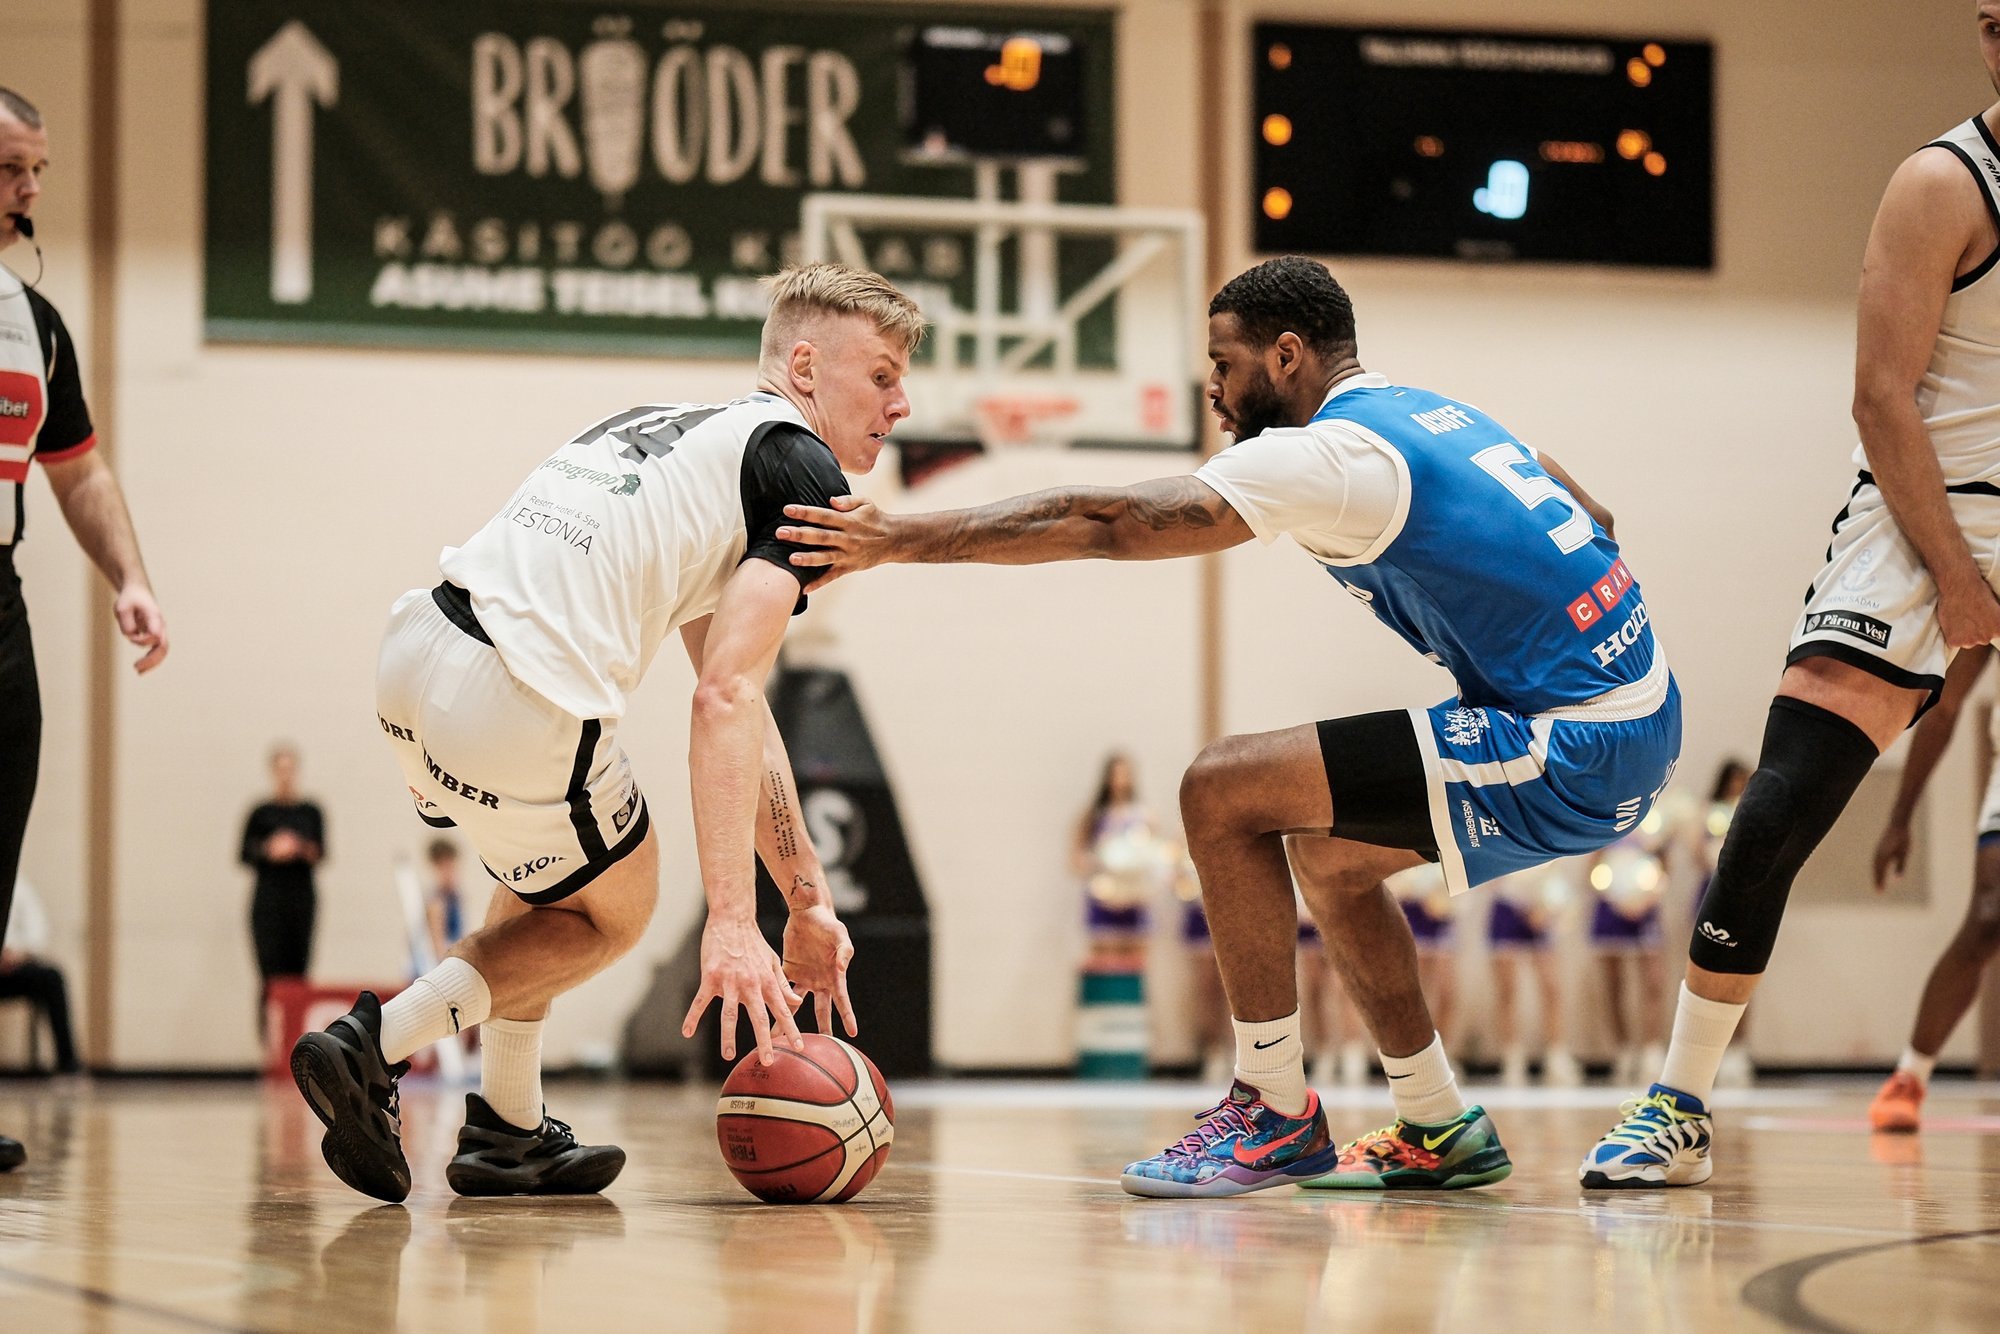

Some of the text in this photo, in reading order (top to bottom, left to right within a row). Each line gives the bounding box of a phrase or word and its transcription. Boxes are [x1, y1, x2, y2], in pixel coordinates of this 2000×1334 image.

[1982, 157, 2000, 189] TRIM
[1469, 442, 1596, 555] 5
[512, 507, 593, 555] ESTONIA
[582, 514, 601, 530] Spa
[1822, 614, 1888, 642] Pärnu Vesi
[377, 709, 499, 810] ORI IMBER
